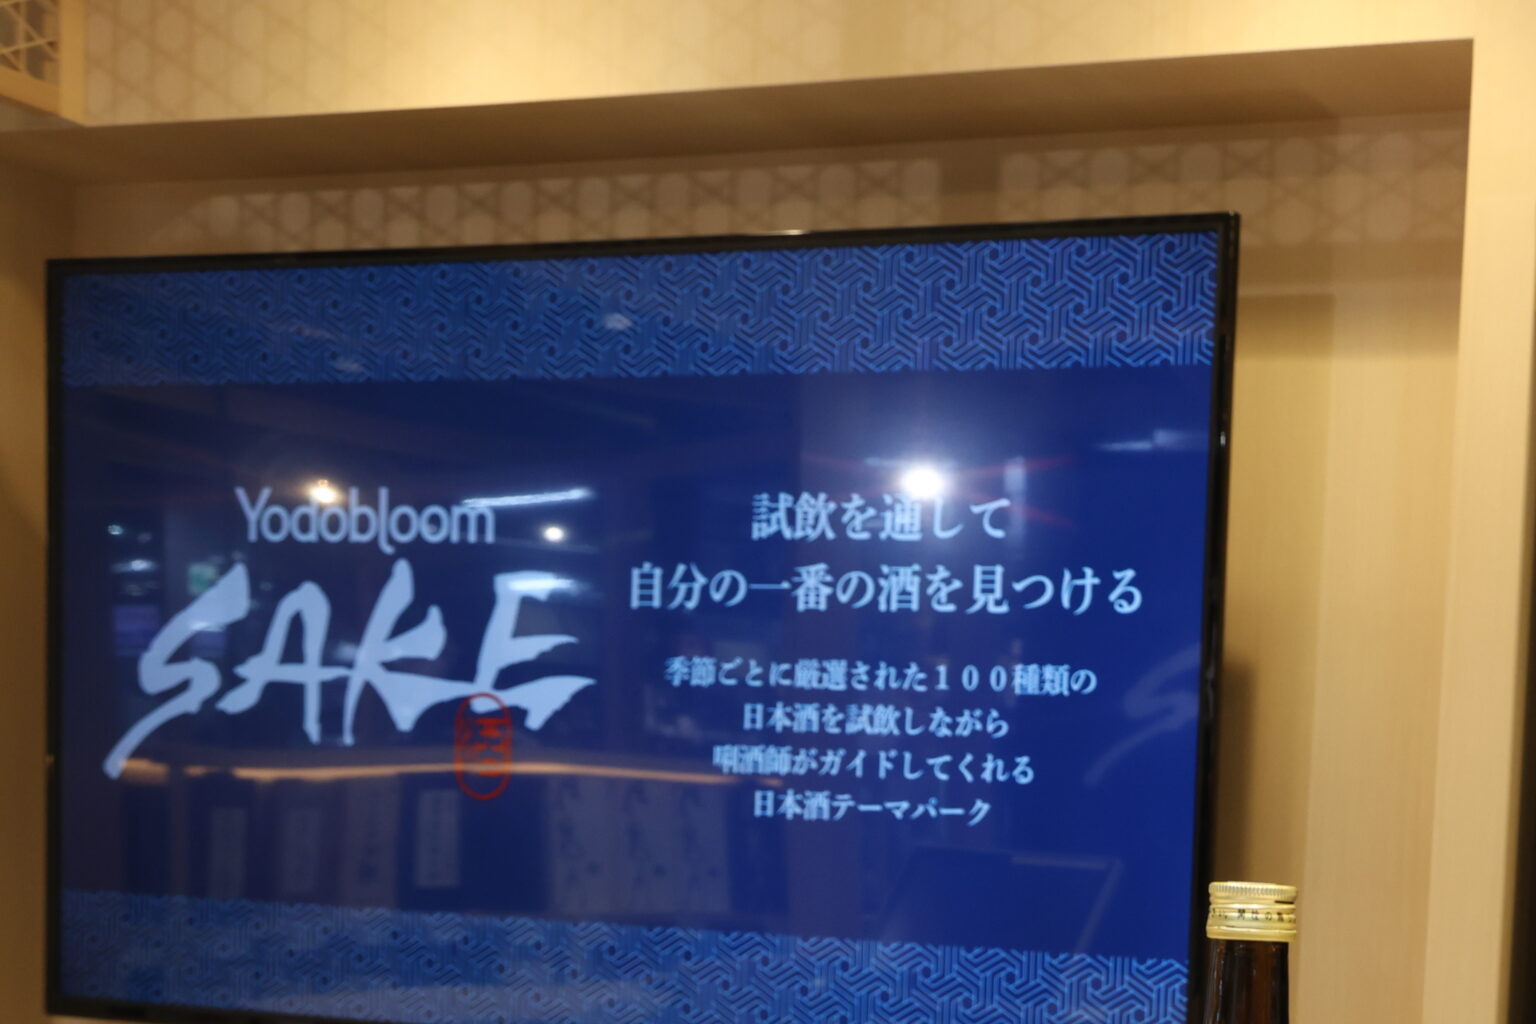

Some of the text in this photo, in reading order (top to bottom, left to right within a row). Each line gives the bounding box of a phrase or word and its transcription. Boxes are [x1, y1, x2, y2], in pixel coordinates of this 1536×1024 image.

[235, 486, 495, 554] Yodobloom
[750, 492, 1010, 542] 試飲を通して
[629, 561, 1144, 616] 自分の一番の酒を見つける
[102, 558, 596, 780] SAKE
[742, 703, 1010, 739] 日本酒を試飲しながら
[752, 790, 992, 826] 日本酒テーマパーク
